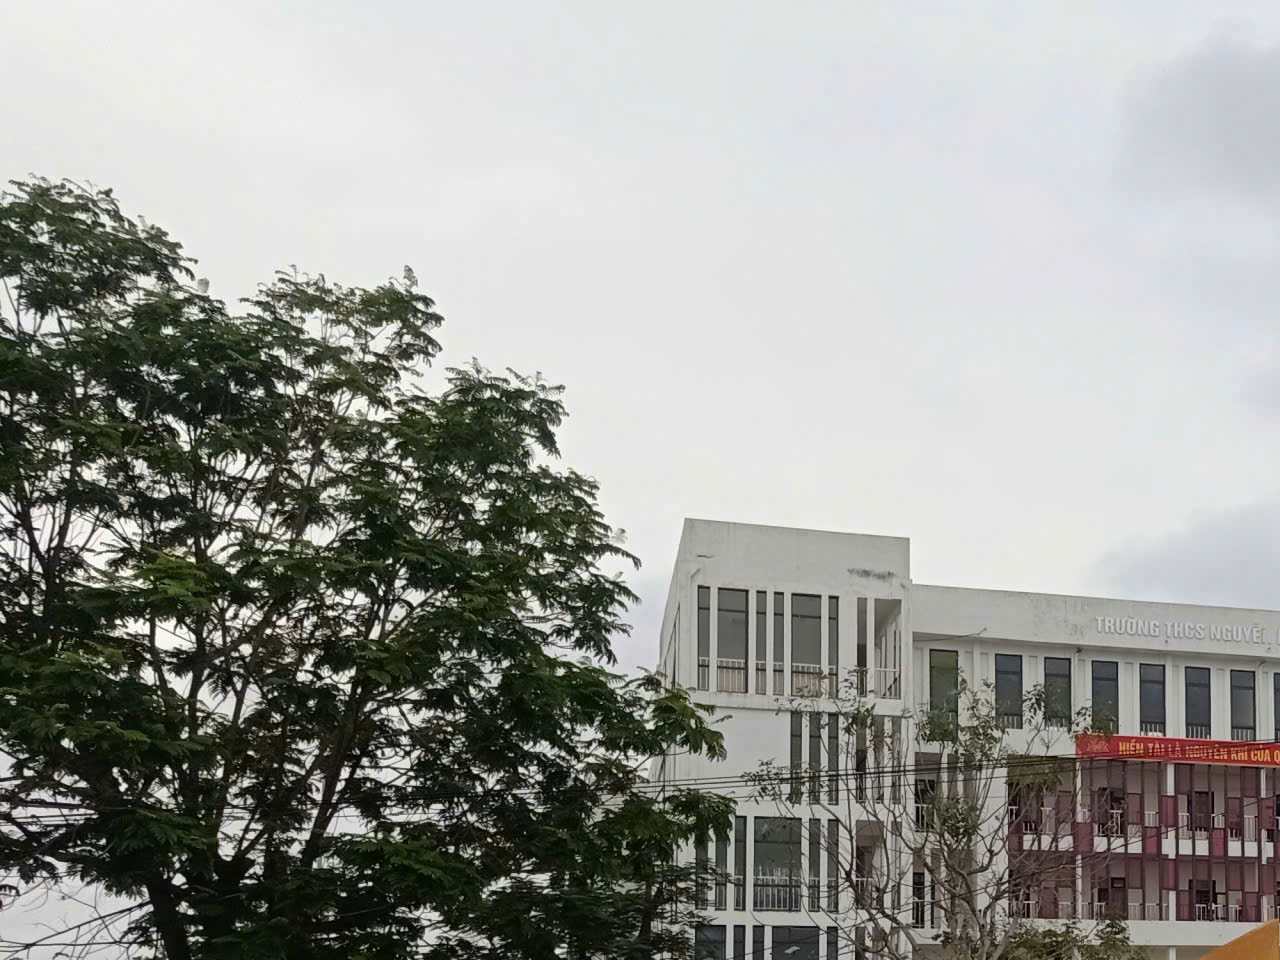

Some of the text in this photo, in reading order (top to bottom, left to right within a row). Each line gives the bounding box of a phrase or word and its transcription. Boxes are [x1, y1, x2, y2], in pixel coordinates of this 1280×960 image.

[1095, 615, 1160, 637] TRƯỜNG
[1164, 621, 1205, 640] THCS
[1185, 743, 1228, 760] NGUYÊN
[1230, 745, 1248, 761] KHÍ
[1250, 745, 1271, 762] CỦA
